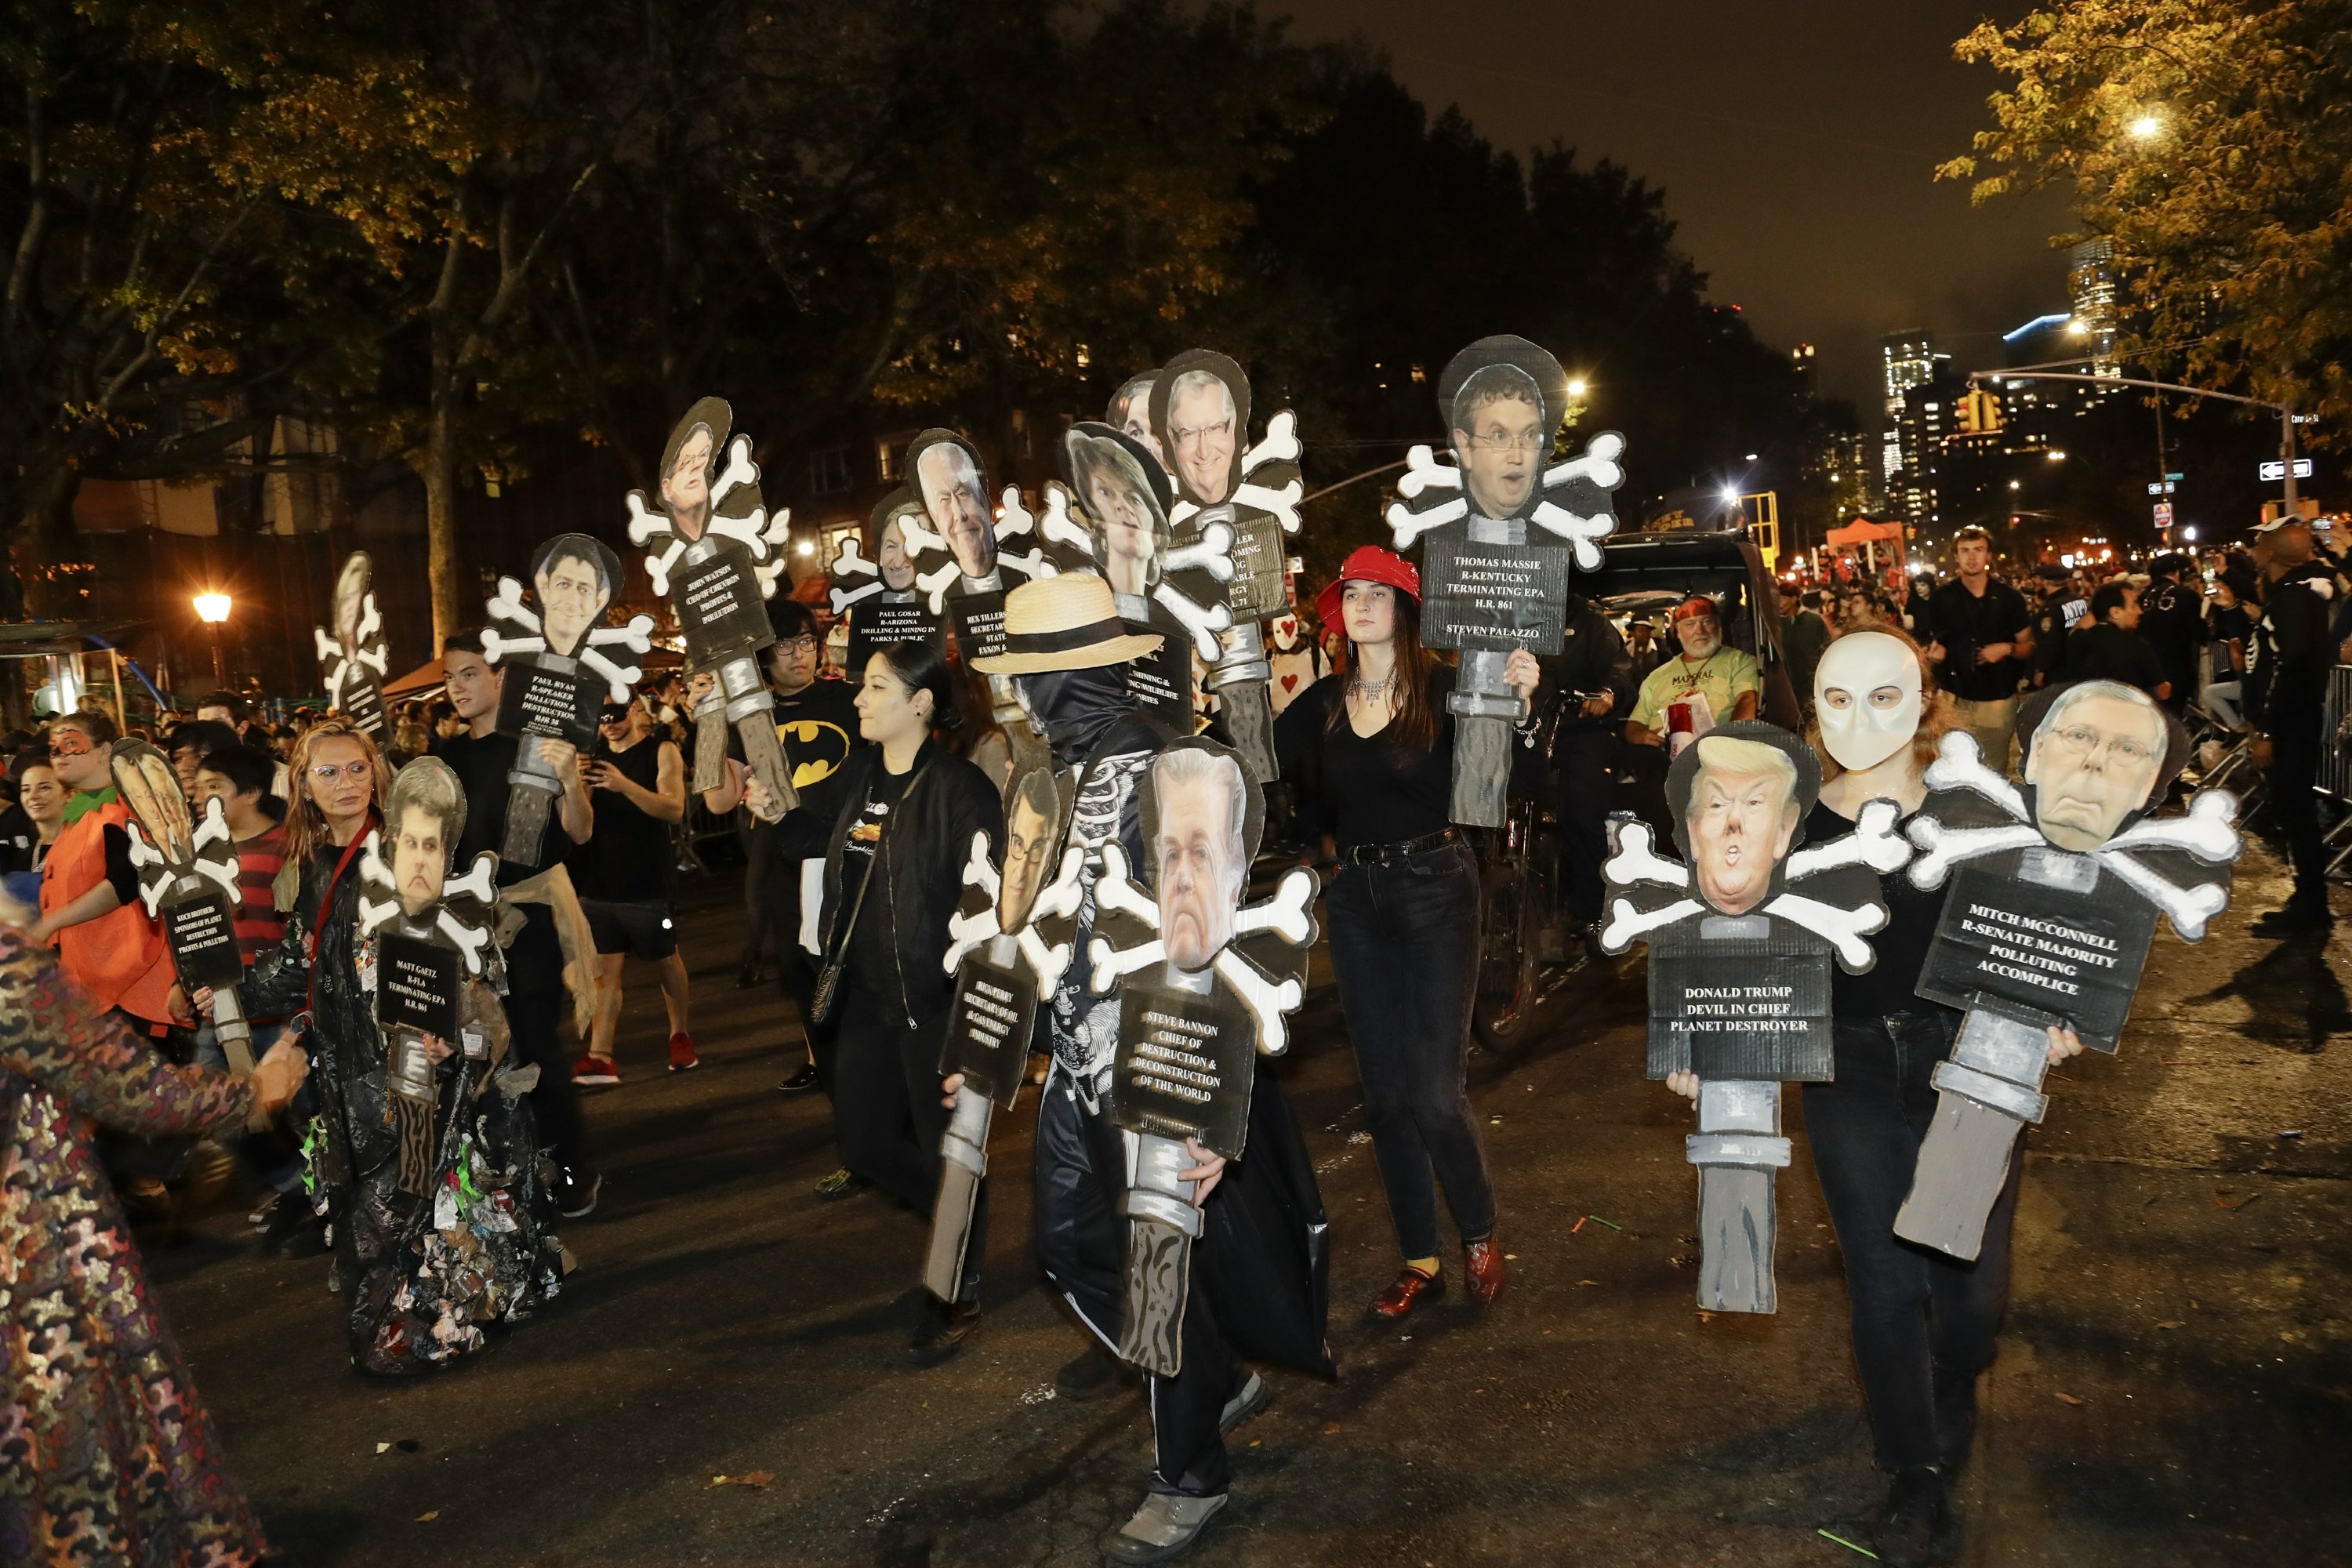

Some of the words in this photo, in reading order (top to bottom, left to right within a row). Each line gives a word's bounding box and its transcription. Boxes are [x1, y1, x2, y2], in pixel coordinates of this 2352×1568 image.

[1232, 544, 1261, 557] OMING
[1454, 557, 1499, 568] THOMAS
[1501, 559, 1541, 569] MASSIE
[688, 578, 706, 592] JOHN
[1461, 571, 1532, 583] R-KENTUCKY
[1446, 583, 1522, 596] TERMINATING
[1524, 588, 1544, 597] EPA
[1475, 599, 1496, 608] H.R.
[1497, 601, 1513, 609] 861
[967, 615, 980, 624] REX
[986, 633, 1007, 643] STATE
[1446, 624, 1487, 634] STEVEN
[1490, 627, 1539, 638] PALAZZO
[978, 644, 1000, 655] EXXON
[533, 676, 554, 687] PAUL
[554, 681, 576, 691] RYAN
[531, 685, 574, 701] R-SPEAKER
[1141, 683, 1179, 701] WILDLIFE
[524, 693, 568, 709] POLLUTION
[521, 701, 575, 720] DESTRUCTION
[177, 913, 191, 922] KOCH
[1969, 903, 2020, 926] MITCH
[2022, 917, 2118, 952] MCCONNELL
[1962, 919, 2034, 948] R-SENATE
[2035, 938, 2119, 969] MAJORITY
[1989, 944, 2078, 977] POLLUTING
[397, 960, 416, 971] MATT
[416, 965, 437, 978] GAETZ
[408, 975, 426, 988] R-FLA
[1977, 960, 2079, 996] ACCOMPLICE
[388, 982, 432, 1000] TERMINATING
[432, 994, 446, 1005] EPA
[977, 980, 993, 996] RICK
[993, 986, 1014, 1003] PERRY
[1686, 988, 1740, 999] DONALD
[1744, 986, 1792, 997] TRUMP
[405, 999, 417, 1009] H.R.
[418, 1002, 427, 1013] 861
[964, 993, 1000, 1014] SECRETARY
[1000, 1007, 1009, 1018] OF
[1008, 1009, 1019, 1022] OIL
[1687, 1004, 1728, 1014] DEVIL
[1731, 1004, 1745, 1014] IN
[1748, 1004, 1791, 1014] CHIEF
[967, 1010, 974, 1019] &
[974, 1013, 986, 1025] GAS
[986, 1018, 1011, 1036] ENERGY
[1148, 1011, 1177, 1027] STEVE
[1179, 1018, 1218, 1036] BANNON
[1670, 1021, 1723, 1032] PLANET
[1725, 1020, 1809, 1032] DESTROYER
[972, 1029, 1001, 1049] INDUSTRY
[1159, 1030, 1188, 1046] CHIEF
[1189, 1037, 1203, 1050] OF
[1142, 1042, 1207, 1068] DESTRUCTION
[1209, 1059, 1217, 1071] &
[1135, 1057, 1221, 1088] DECONSTRUCTION
[1140, 1075, 1153, 1087] OF
[1155, 1079, 1174, 1093] THE
[1176, 1083, 1211, 1102] WORLD
